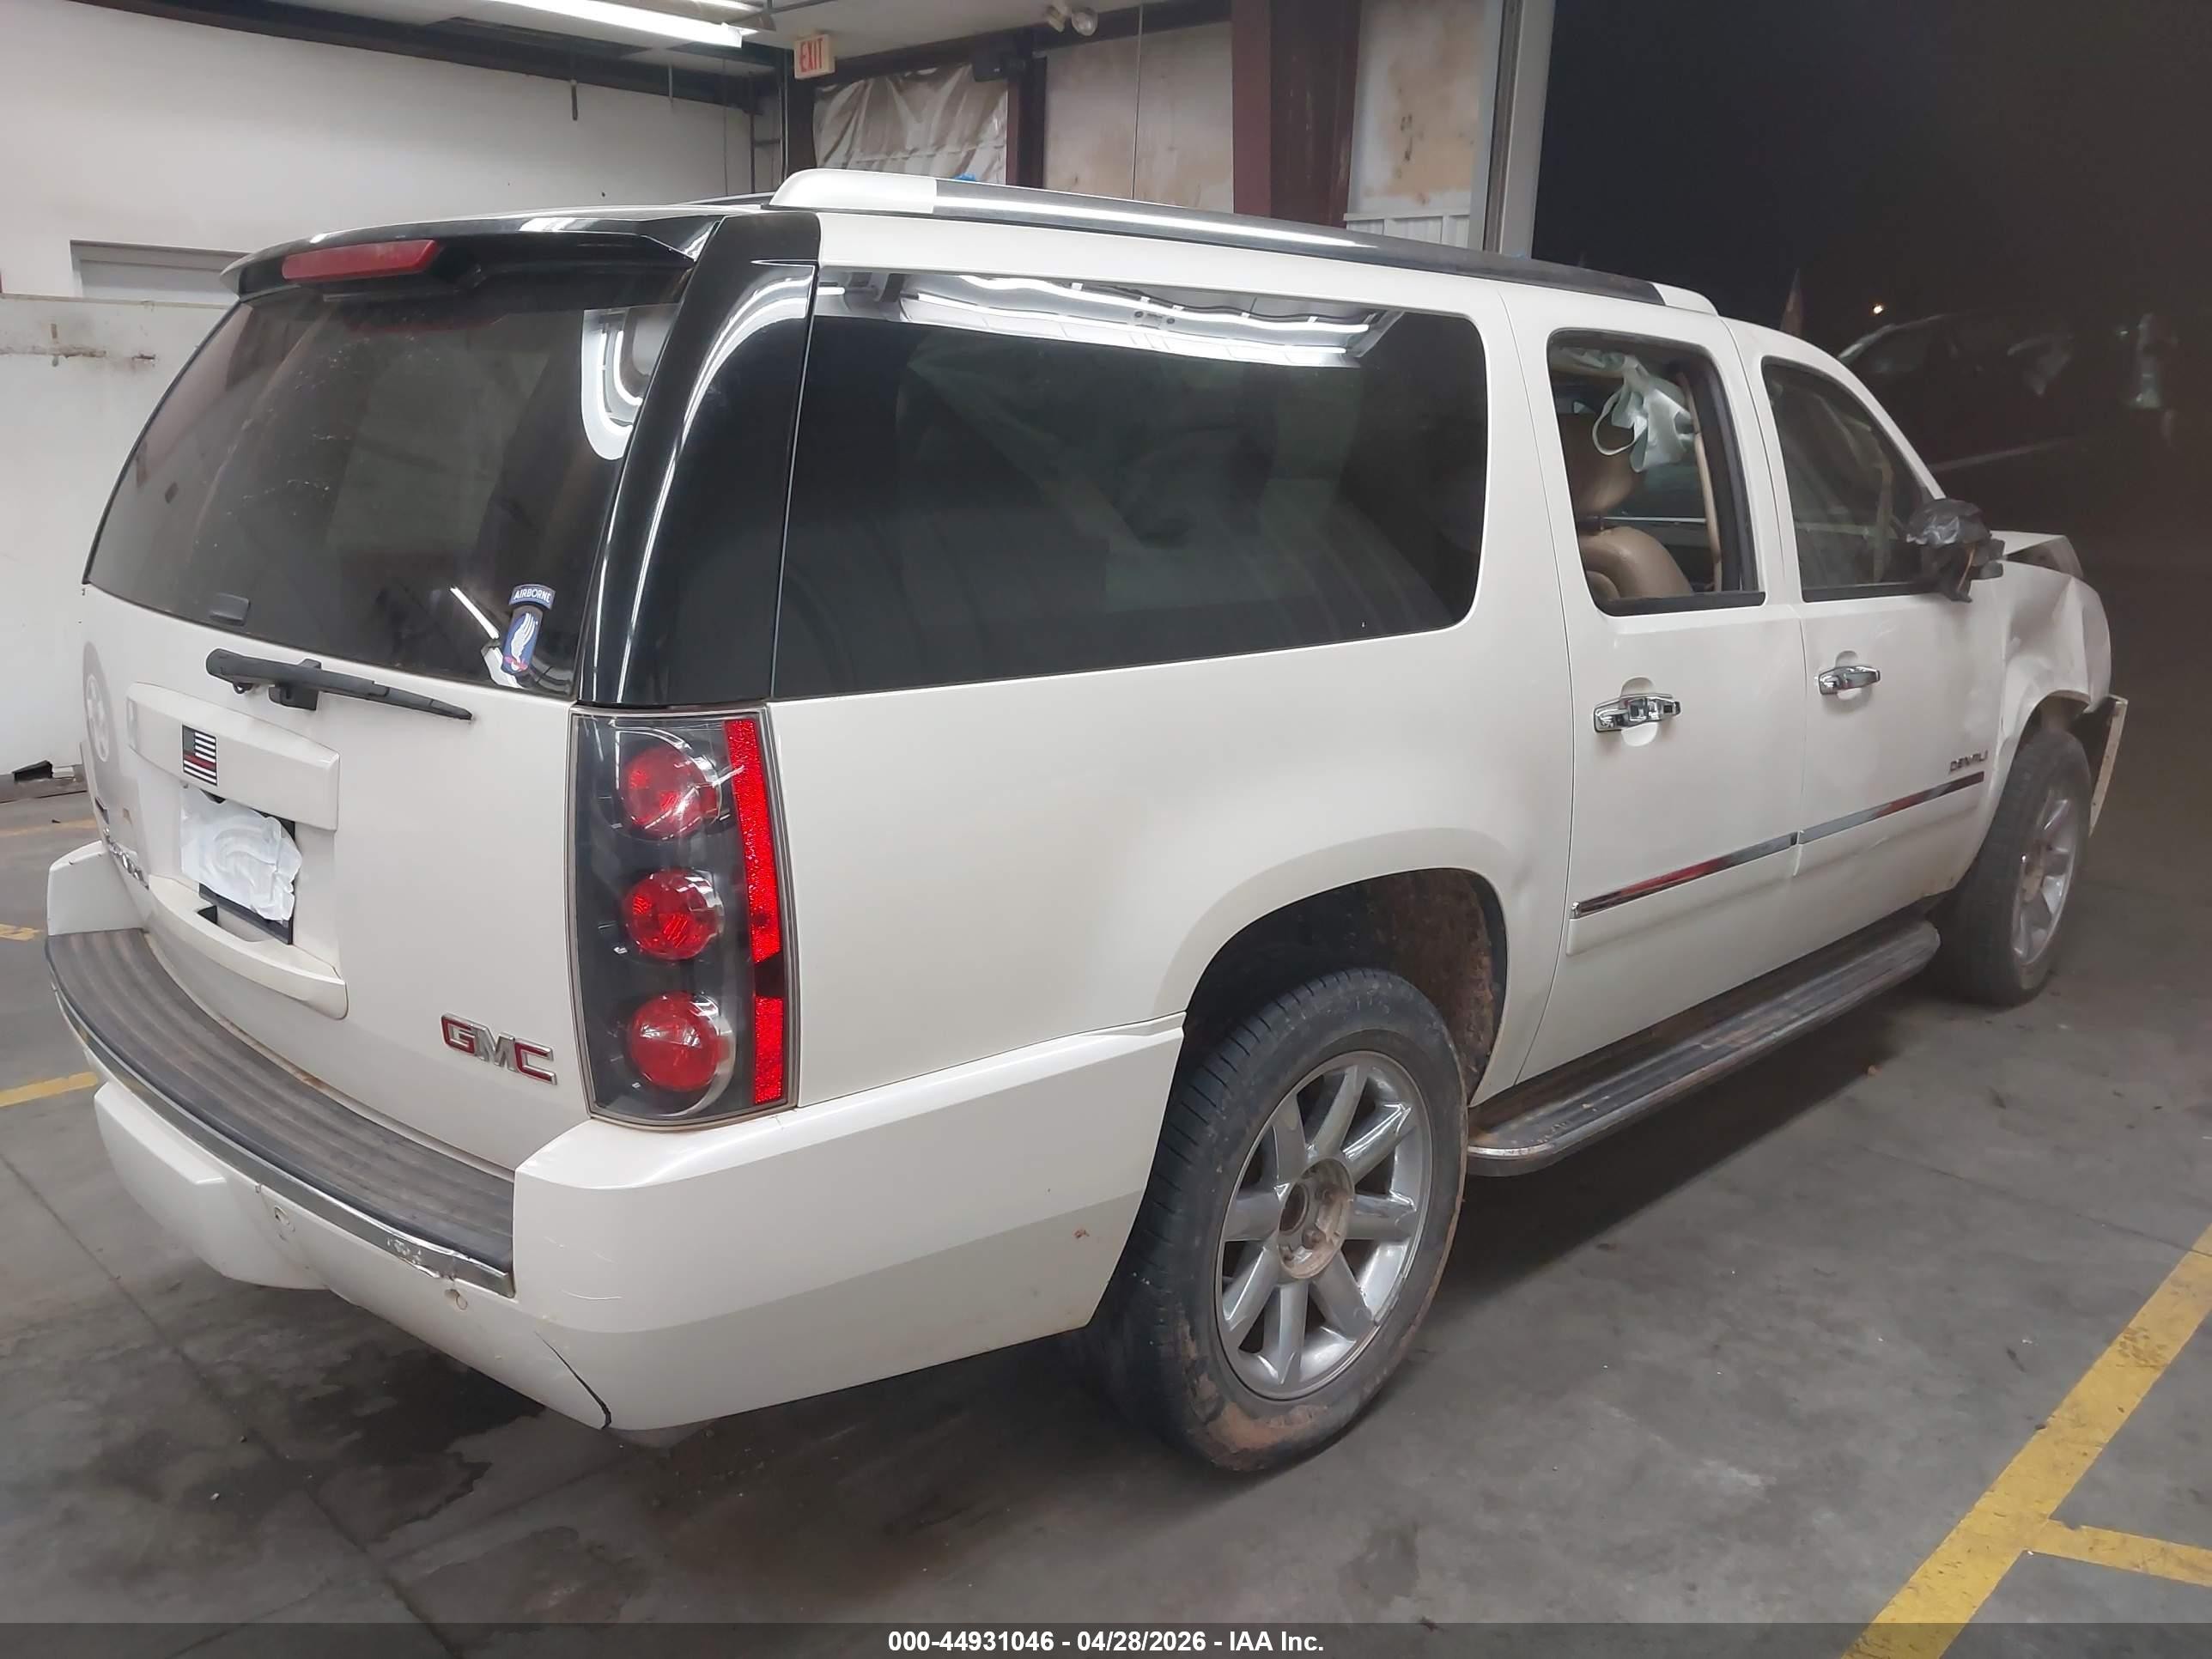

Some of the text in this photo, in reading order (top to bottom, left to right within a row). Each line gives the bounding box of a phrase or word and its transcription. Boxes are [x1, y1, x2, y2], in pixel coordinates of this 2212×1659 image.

[799, 38, 825, 73] EXIT
[514, 588, 552, 603] AIRBORNE
[441, 1012, 558, 1085] GMC
